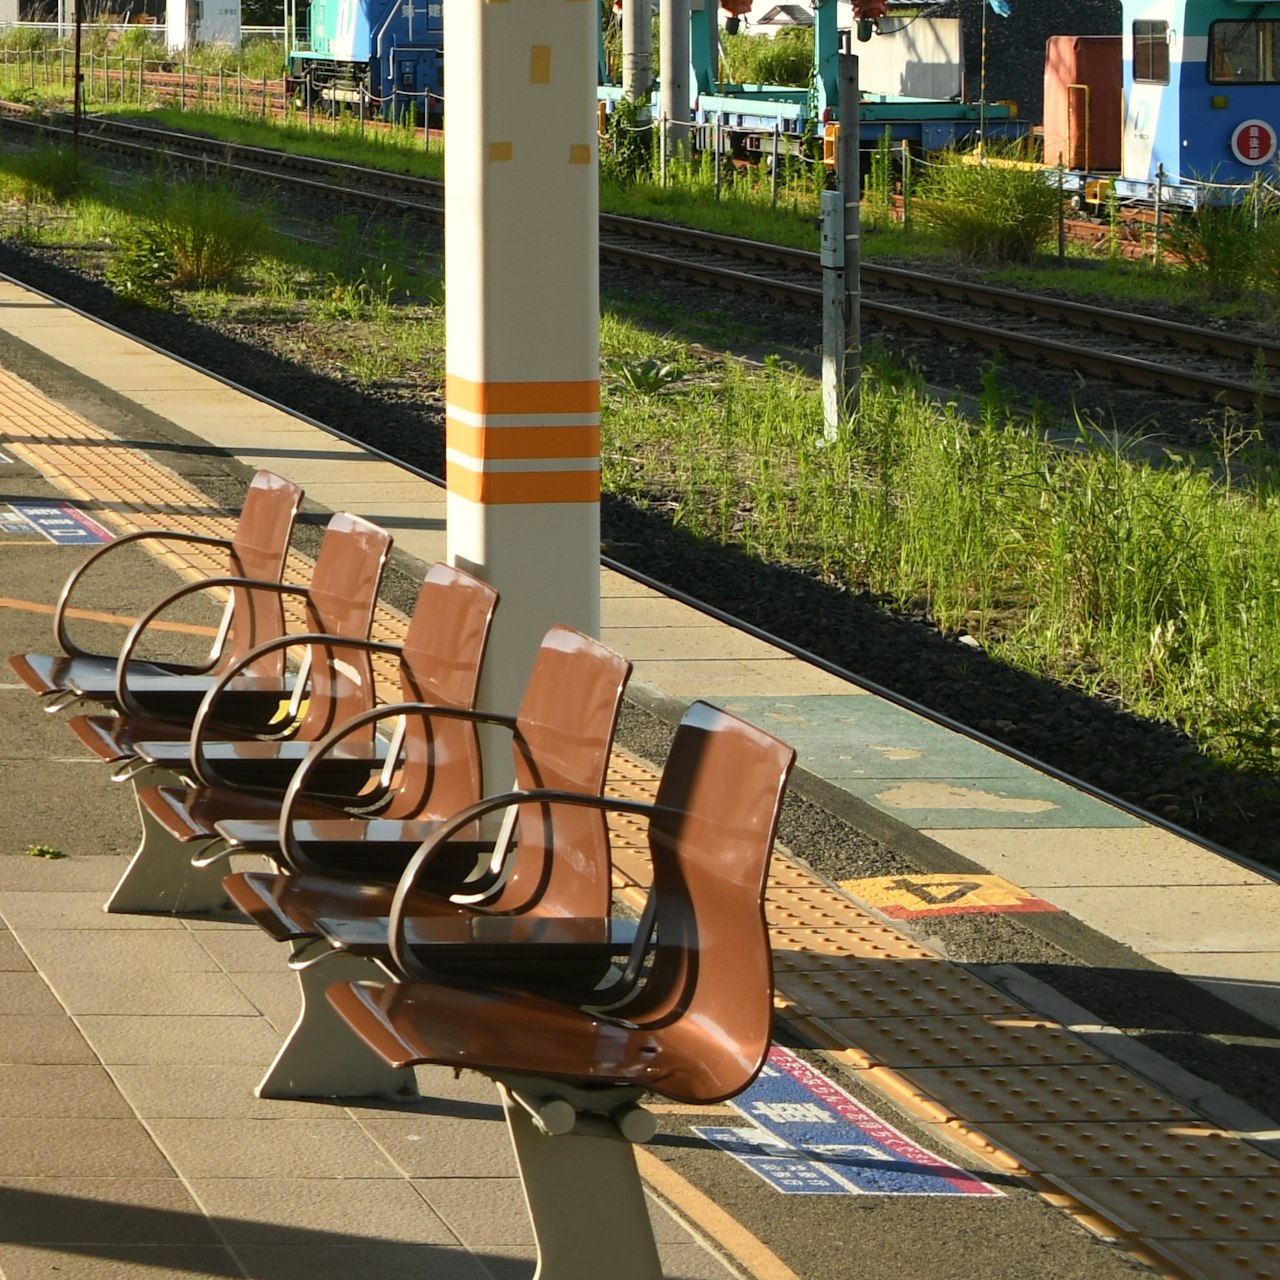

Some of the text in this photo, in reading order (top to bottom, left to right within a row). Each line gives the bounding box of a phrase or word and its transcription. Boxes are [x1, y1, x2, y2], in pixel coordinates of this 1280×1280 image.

[401, 4, 443, 19] 第一建
[886, 877, 982, 905] 4
